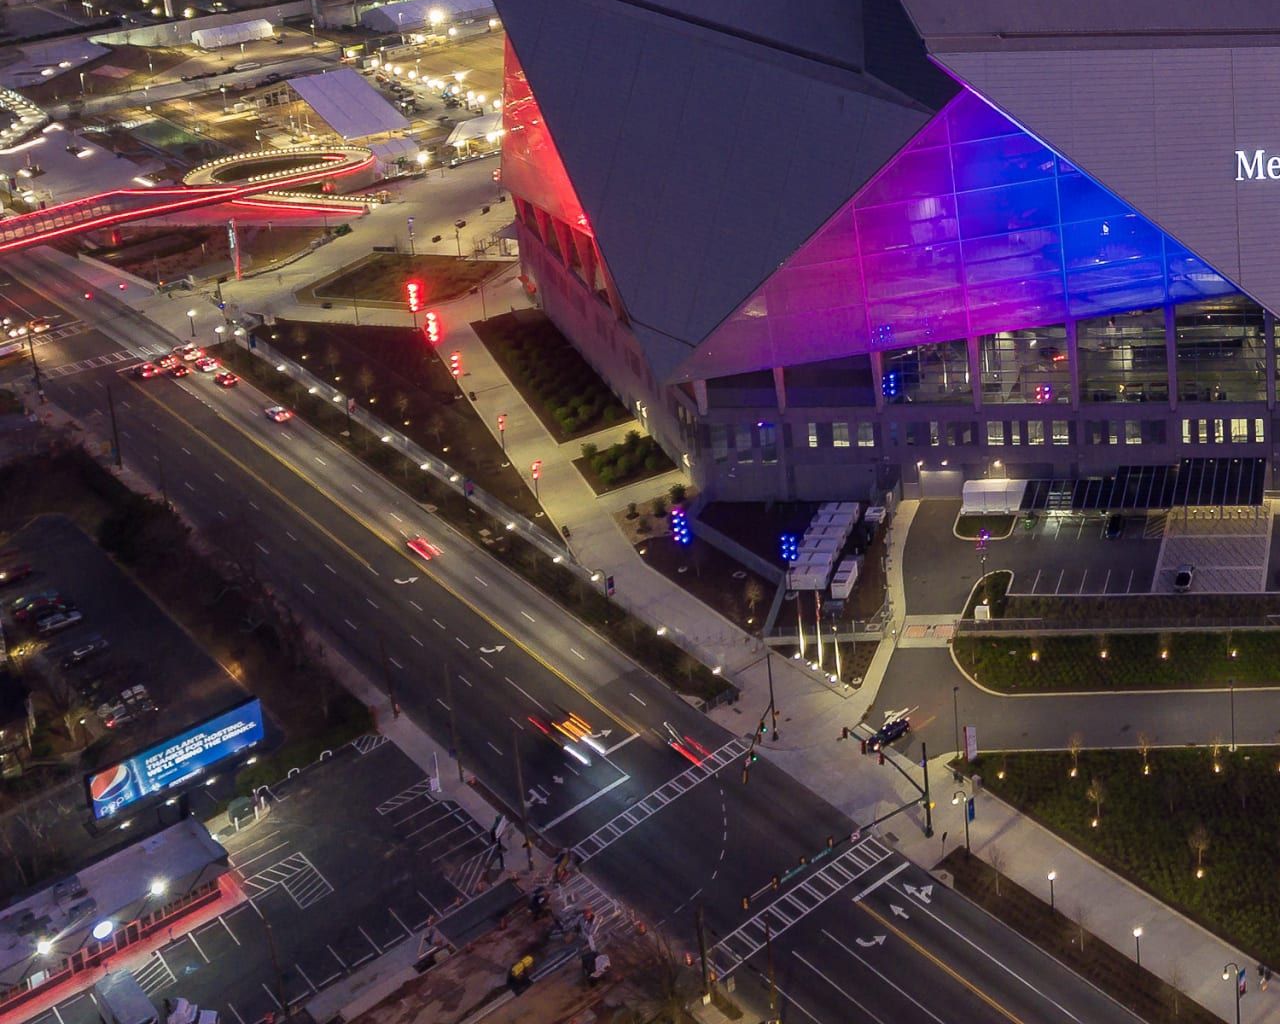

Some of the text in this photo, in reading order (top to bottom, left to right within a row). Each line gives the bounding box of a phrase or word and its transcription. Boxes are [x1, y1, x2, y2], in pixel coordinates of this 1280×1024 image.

[145, 752, 164, 765] HEY
[147, 748, 185, 771] THANKS
[185, 740, 203, 753] FOR
[174, 746, 203, 764] BRING
[203, 738, 222, 750] THE
[100, 791, 134, 817] pepsi
